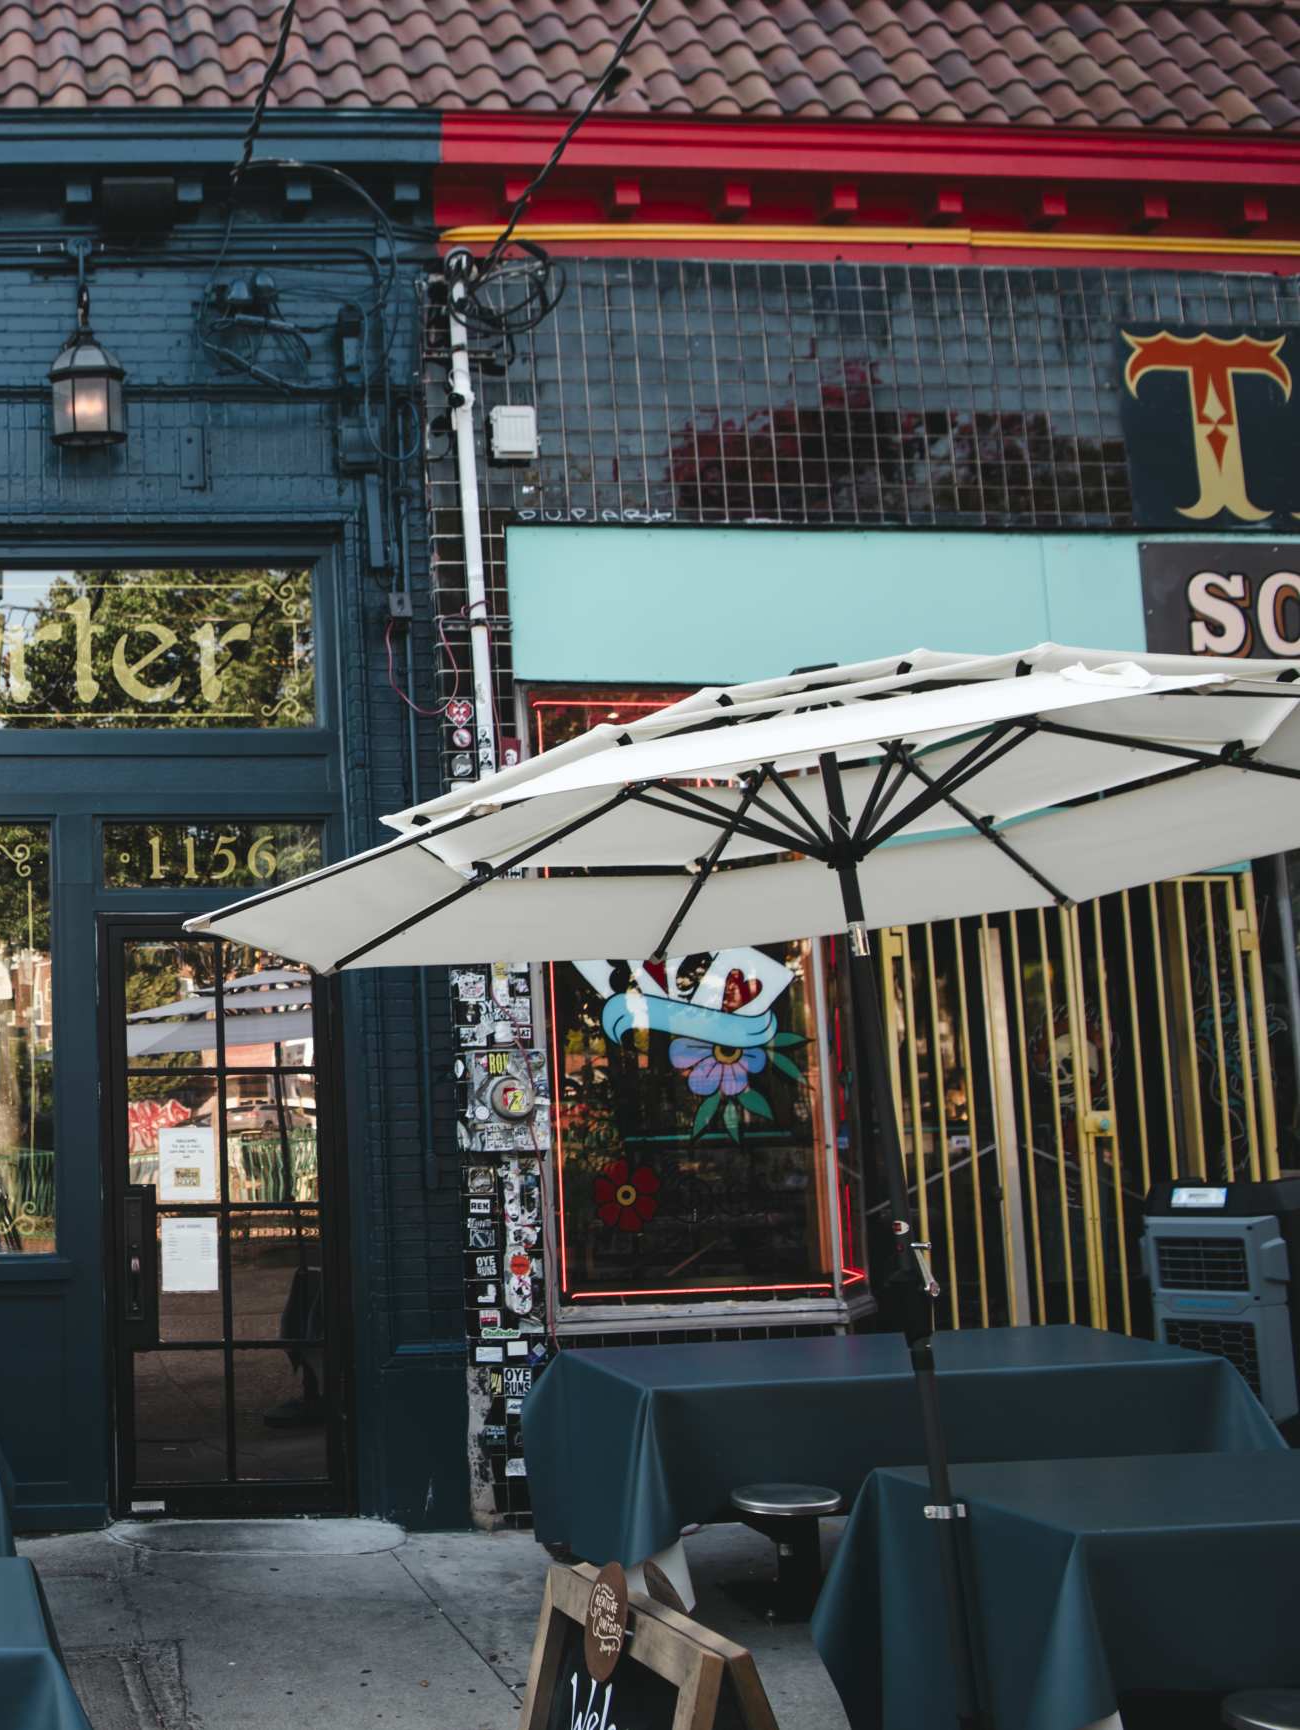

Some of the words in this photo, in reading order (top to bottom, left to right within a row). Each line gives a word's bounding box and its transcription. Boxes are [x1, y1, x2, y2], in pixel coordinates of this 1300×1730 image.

[1121, 330, 1300, 521] T
[148, 835, 278, 880] 1156
[504, 1369, 531, 1382] OYE
[504, 1382, 532, 1397] RUNS
